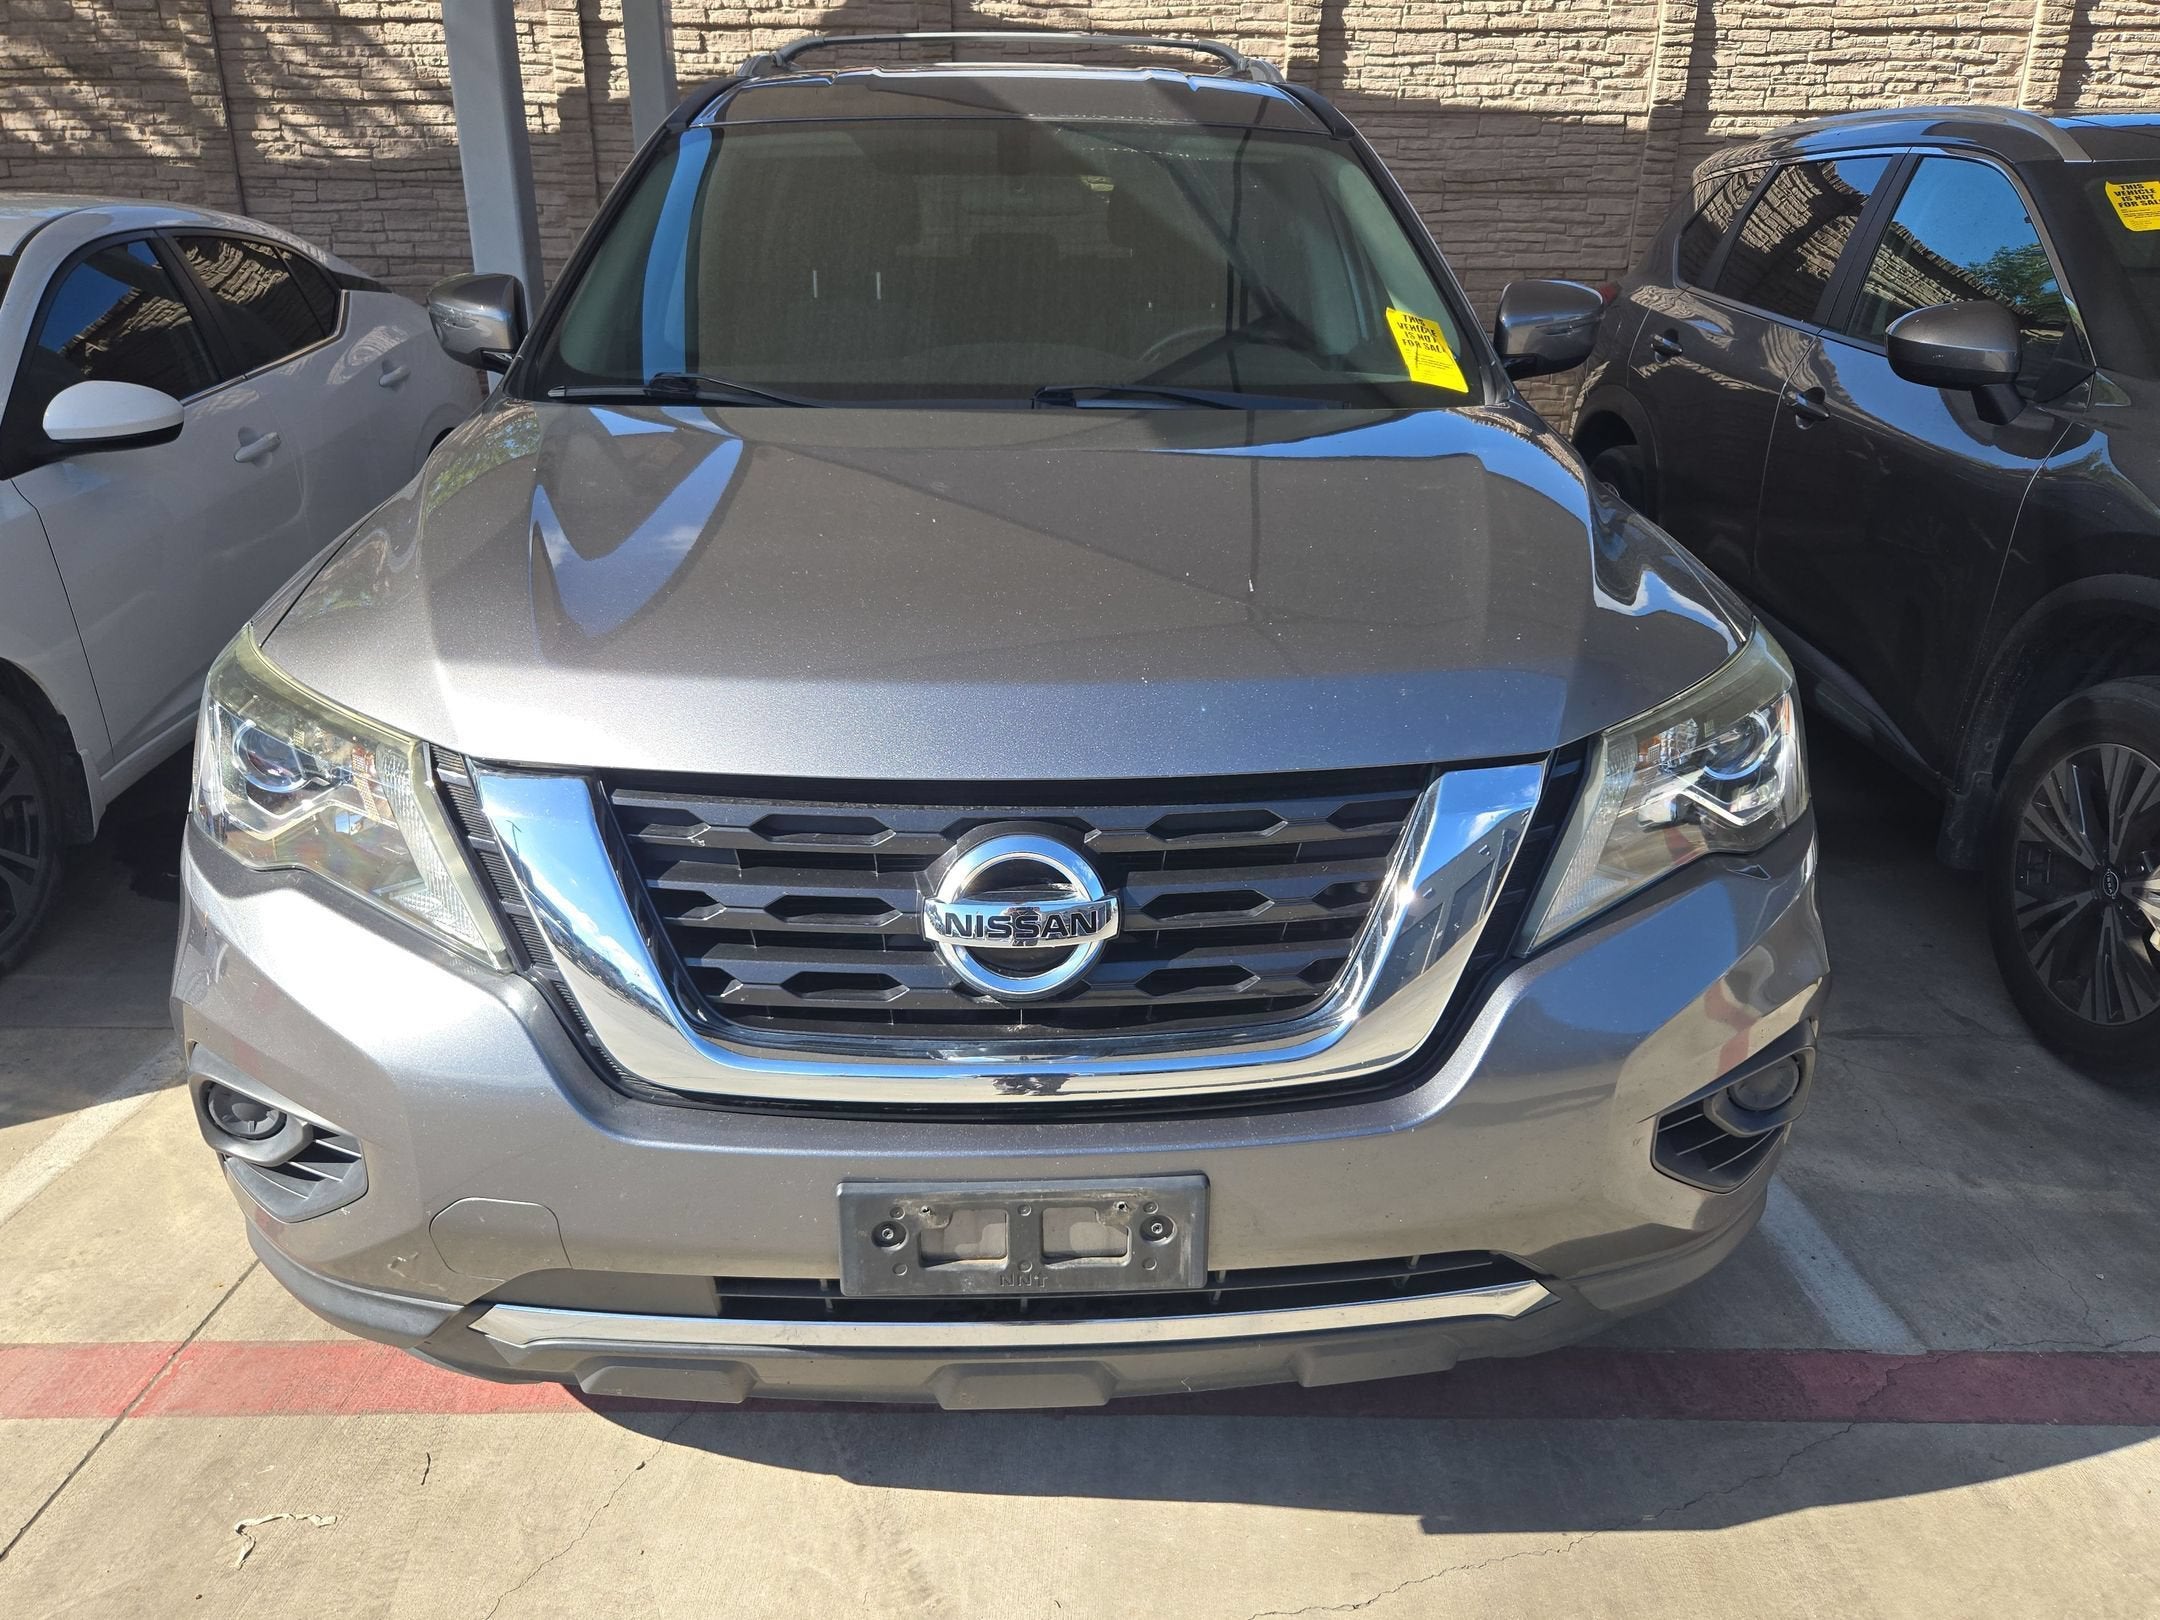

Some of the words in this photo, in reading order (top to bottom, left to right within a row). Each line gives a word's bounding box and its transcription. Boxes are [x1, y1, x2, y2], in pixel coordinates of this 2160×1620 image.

[2114, 188, 2156, 196] VEHICLE
[1403, 314, 1426, 327] THIS
[1397, 321, 1438, 338] VEHICLE
[1405, 331, 1416, 339] IS
[1418, 334, 1437, 343] NOT
[1402, 338, 1422, 349] FOR
[944, 910, 1099, 939] NISSAN
